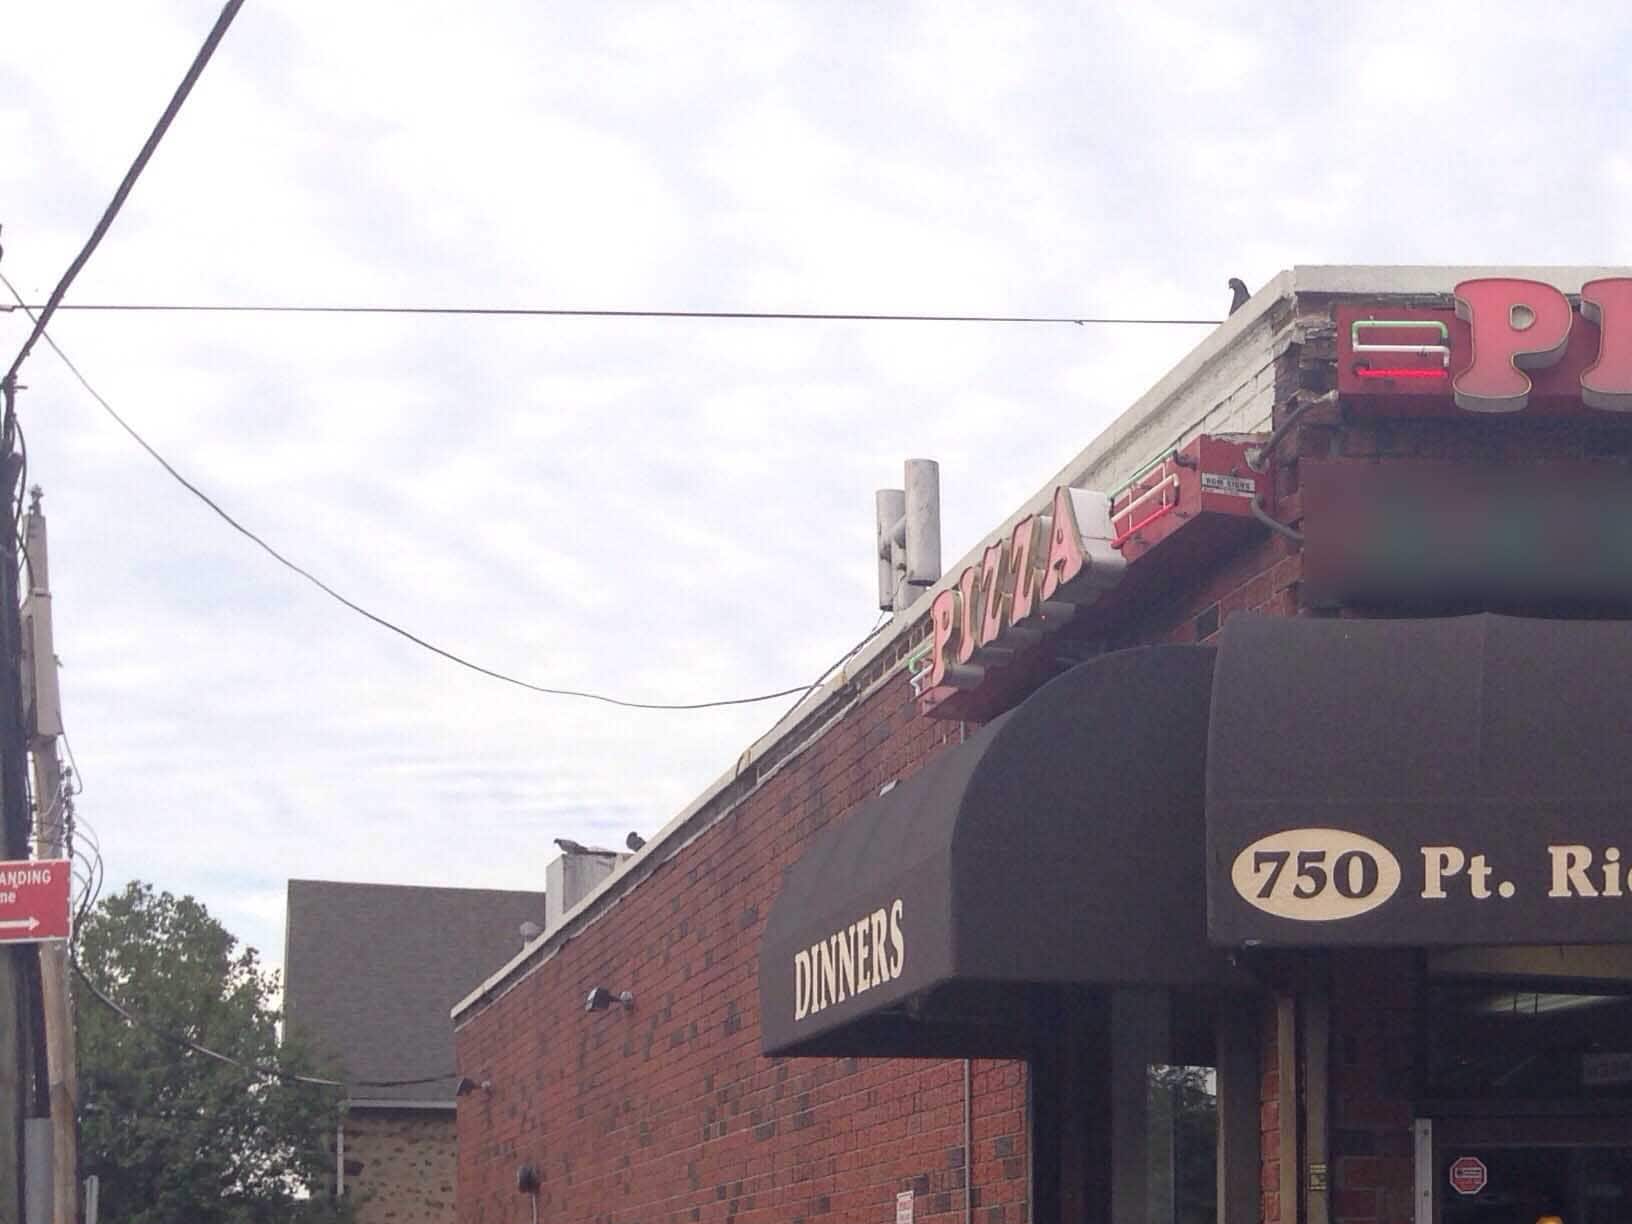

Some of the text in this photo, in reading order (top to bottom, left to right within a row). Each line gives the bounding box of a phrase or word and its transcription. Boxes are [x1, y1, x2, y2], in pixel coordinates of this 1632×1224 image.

[930, 485, 1087, 688] PIZZA
[1253, 850, 1379, 899] 750
[1420, 845, 1515, 899] Pt.
[794, 899, 905, 1022] DINNERS
